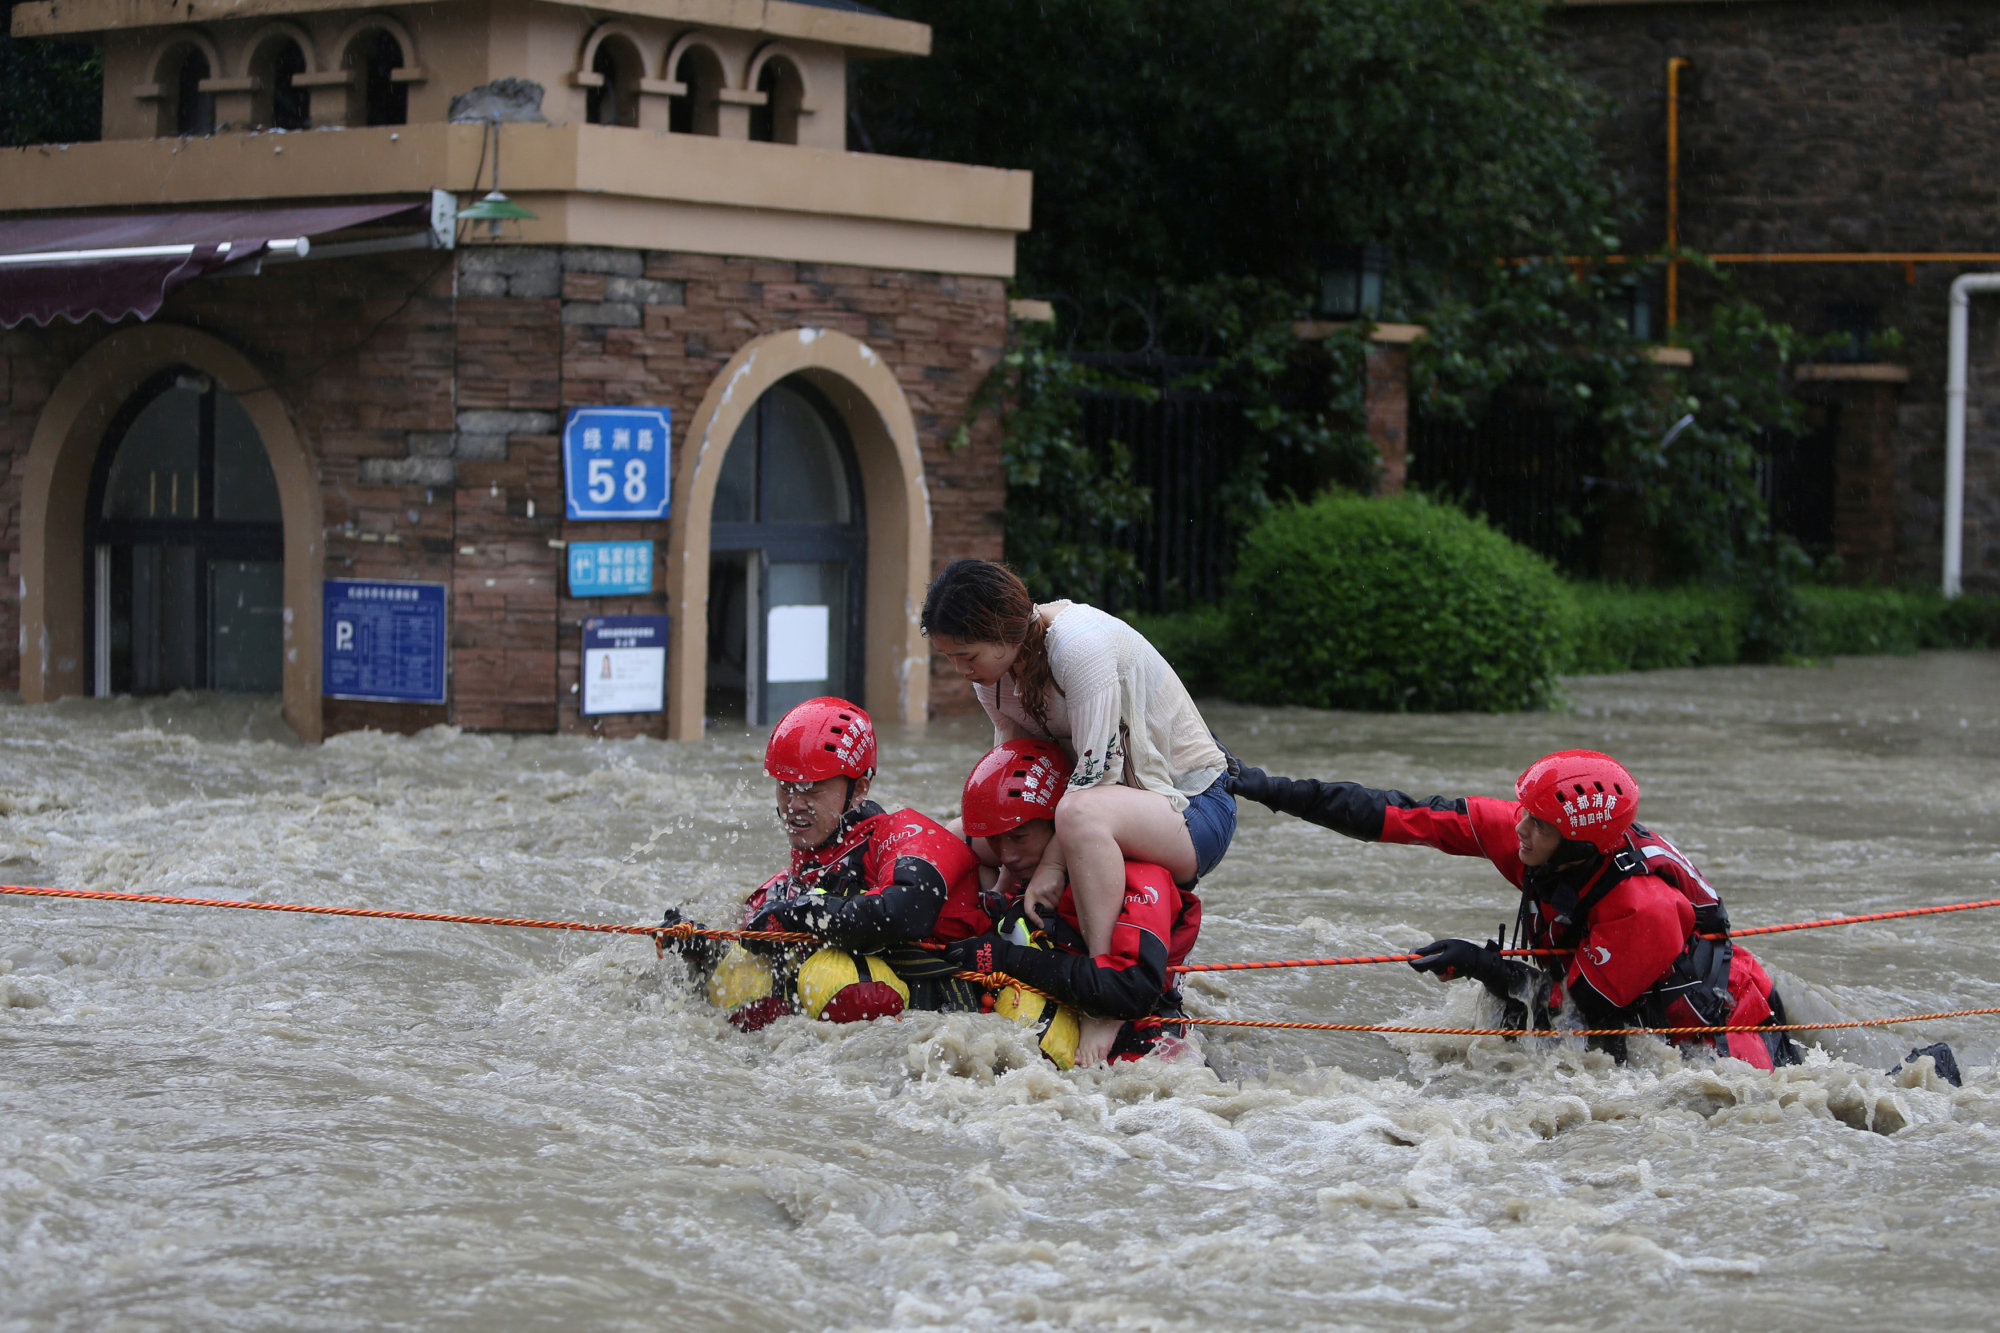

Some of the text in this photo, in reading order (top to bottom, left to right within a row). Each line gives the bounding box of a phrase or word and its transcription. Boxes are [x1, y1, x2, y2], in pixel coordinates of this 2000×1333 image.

[588, 458, 647, 503] 58
[336, 620, 353, 651] P
[836, 718, 867, 762] 成都消防
[1022, 756, 1053, 804] 成都消防
[1562, 792, 1618, 817] 成都消防
[1569, 808, 1613, 828] 特勤四中队
[984, 943, 993, 972] SNOW
